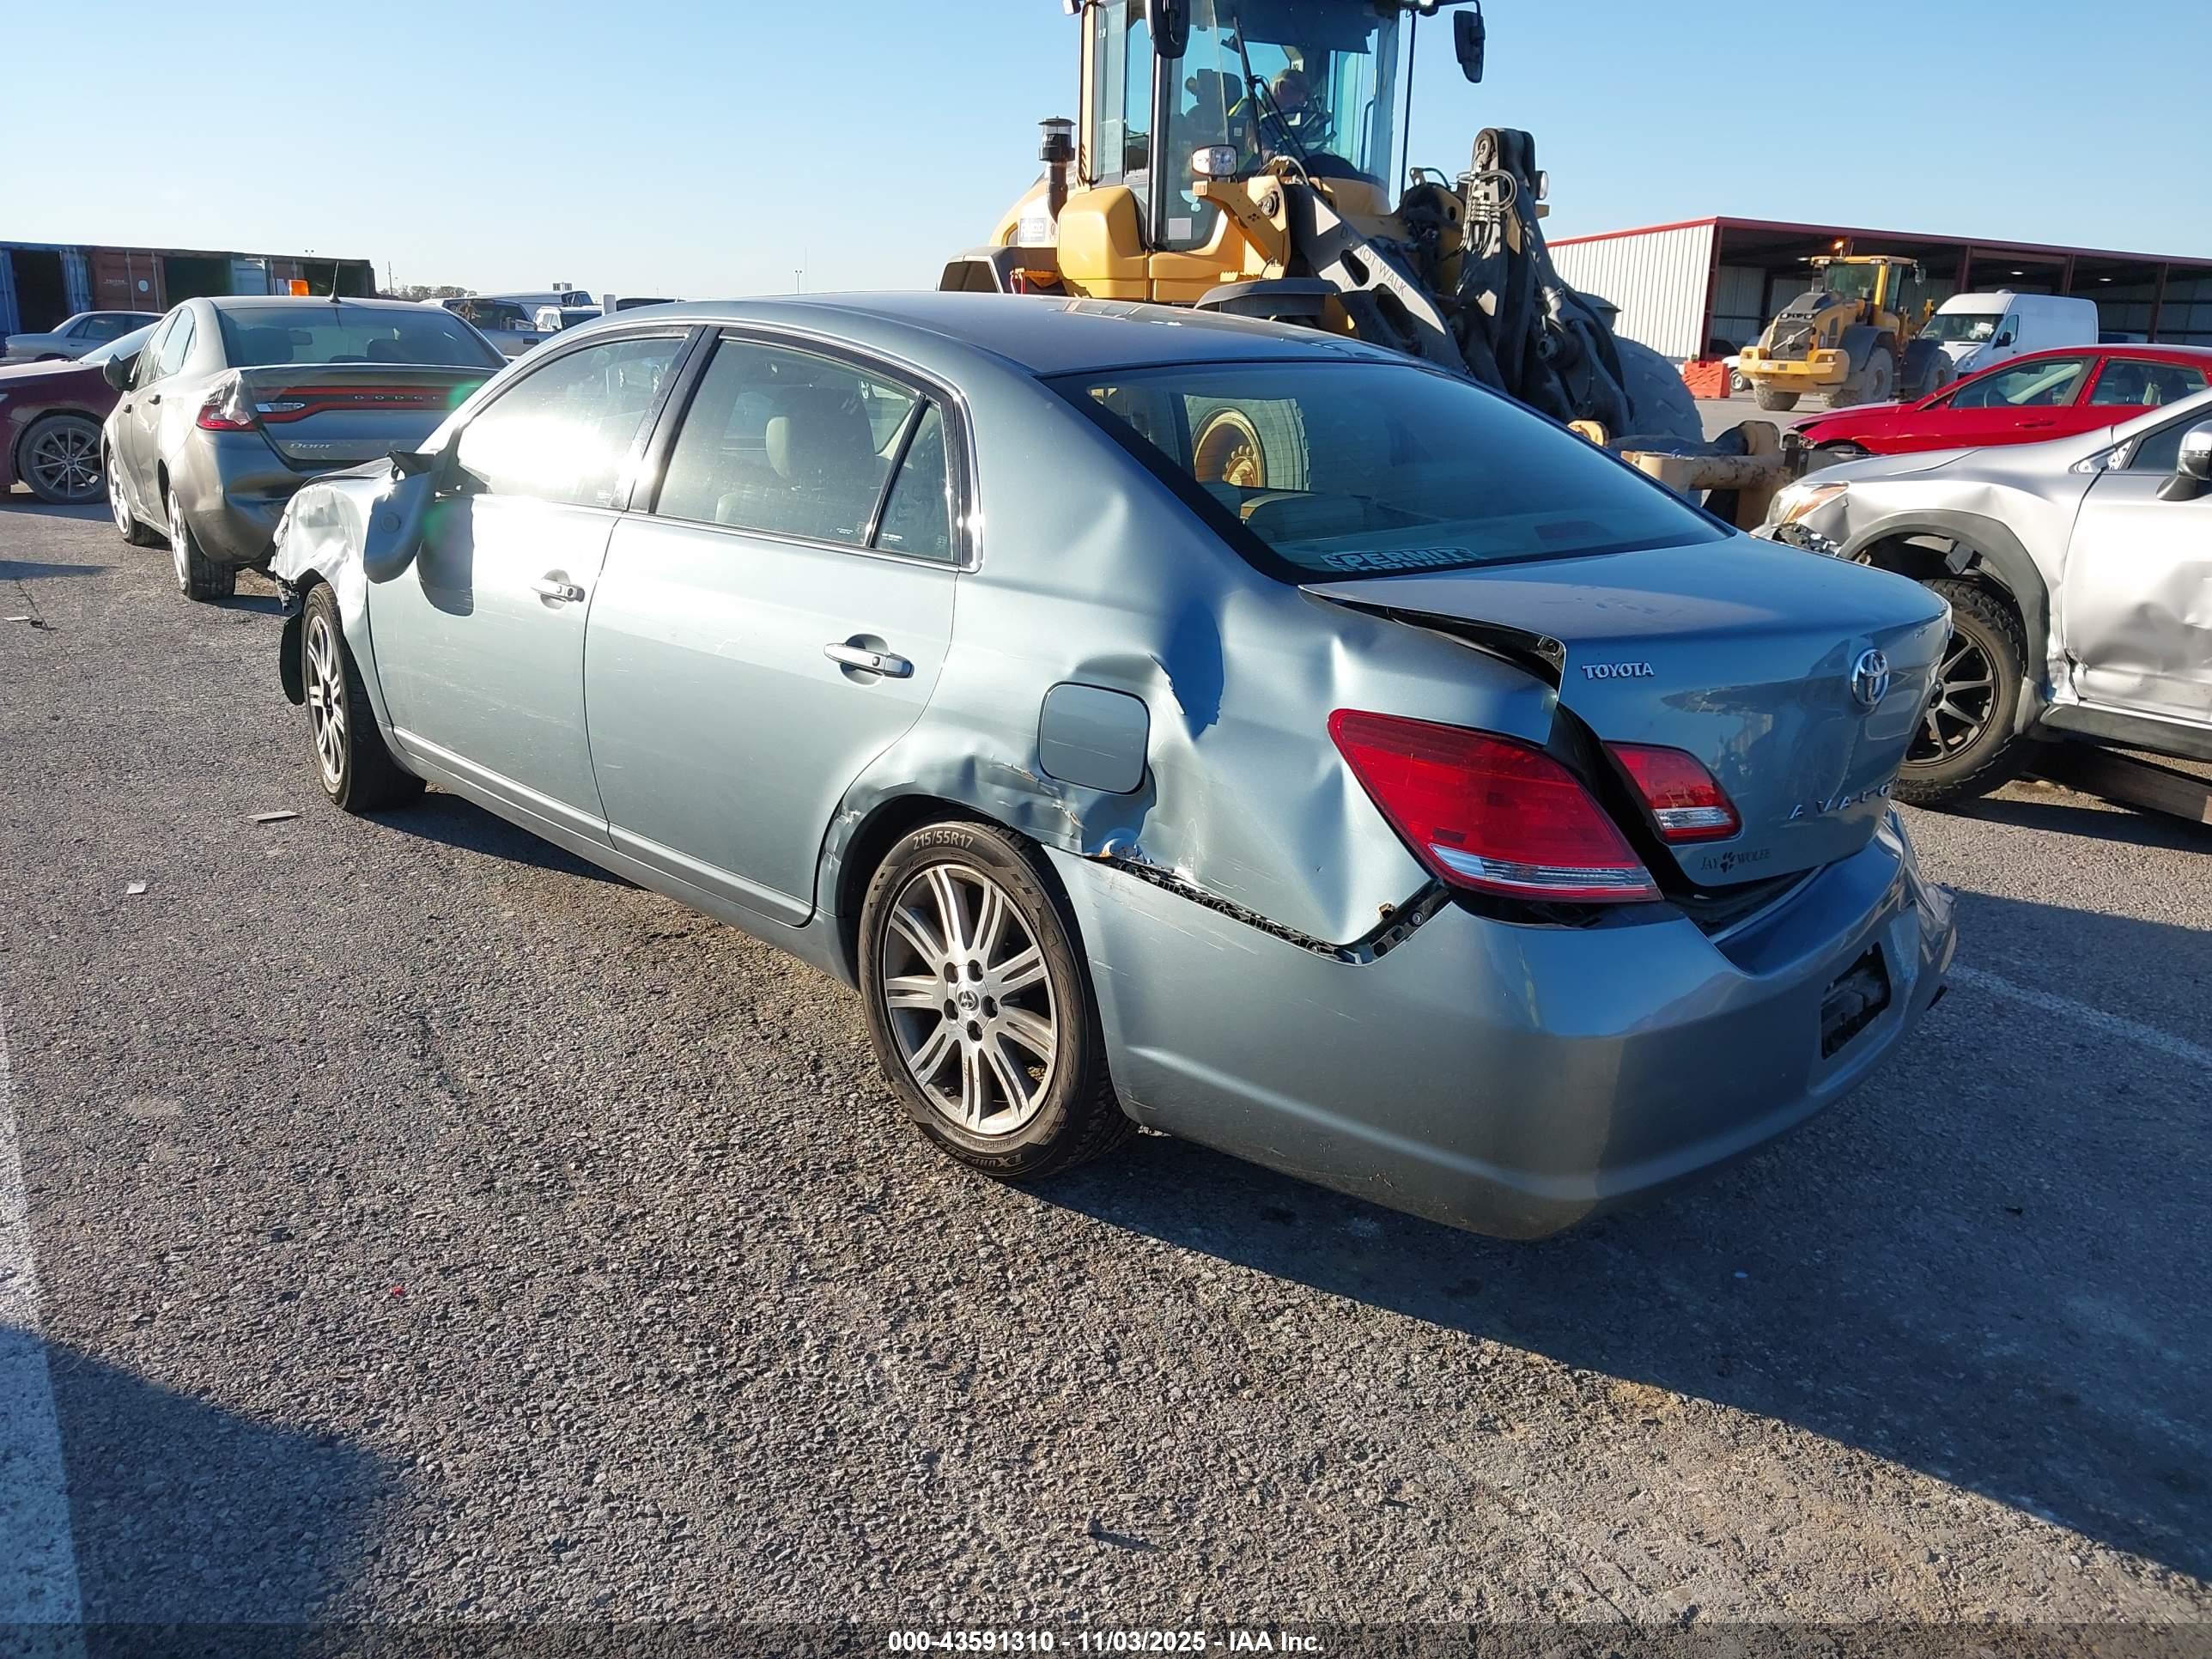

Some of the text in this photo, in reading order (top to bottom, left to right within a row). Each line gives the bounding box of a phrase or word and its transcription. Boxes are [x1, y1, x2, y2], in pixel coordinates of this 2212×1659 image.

[1379, 261, 1407, 297] WALK
[1339, 549, 1457, 568] PERMIT
[1582, 662, 1656, 679] TOYOTA
[913, 830, 974, 850] 215/55R17
